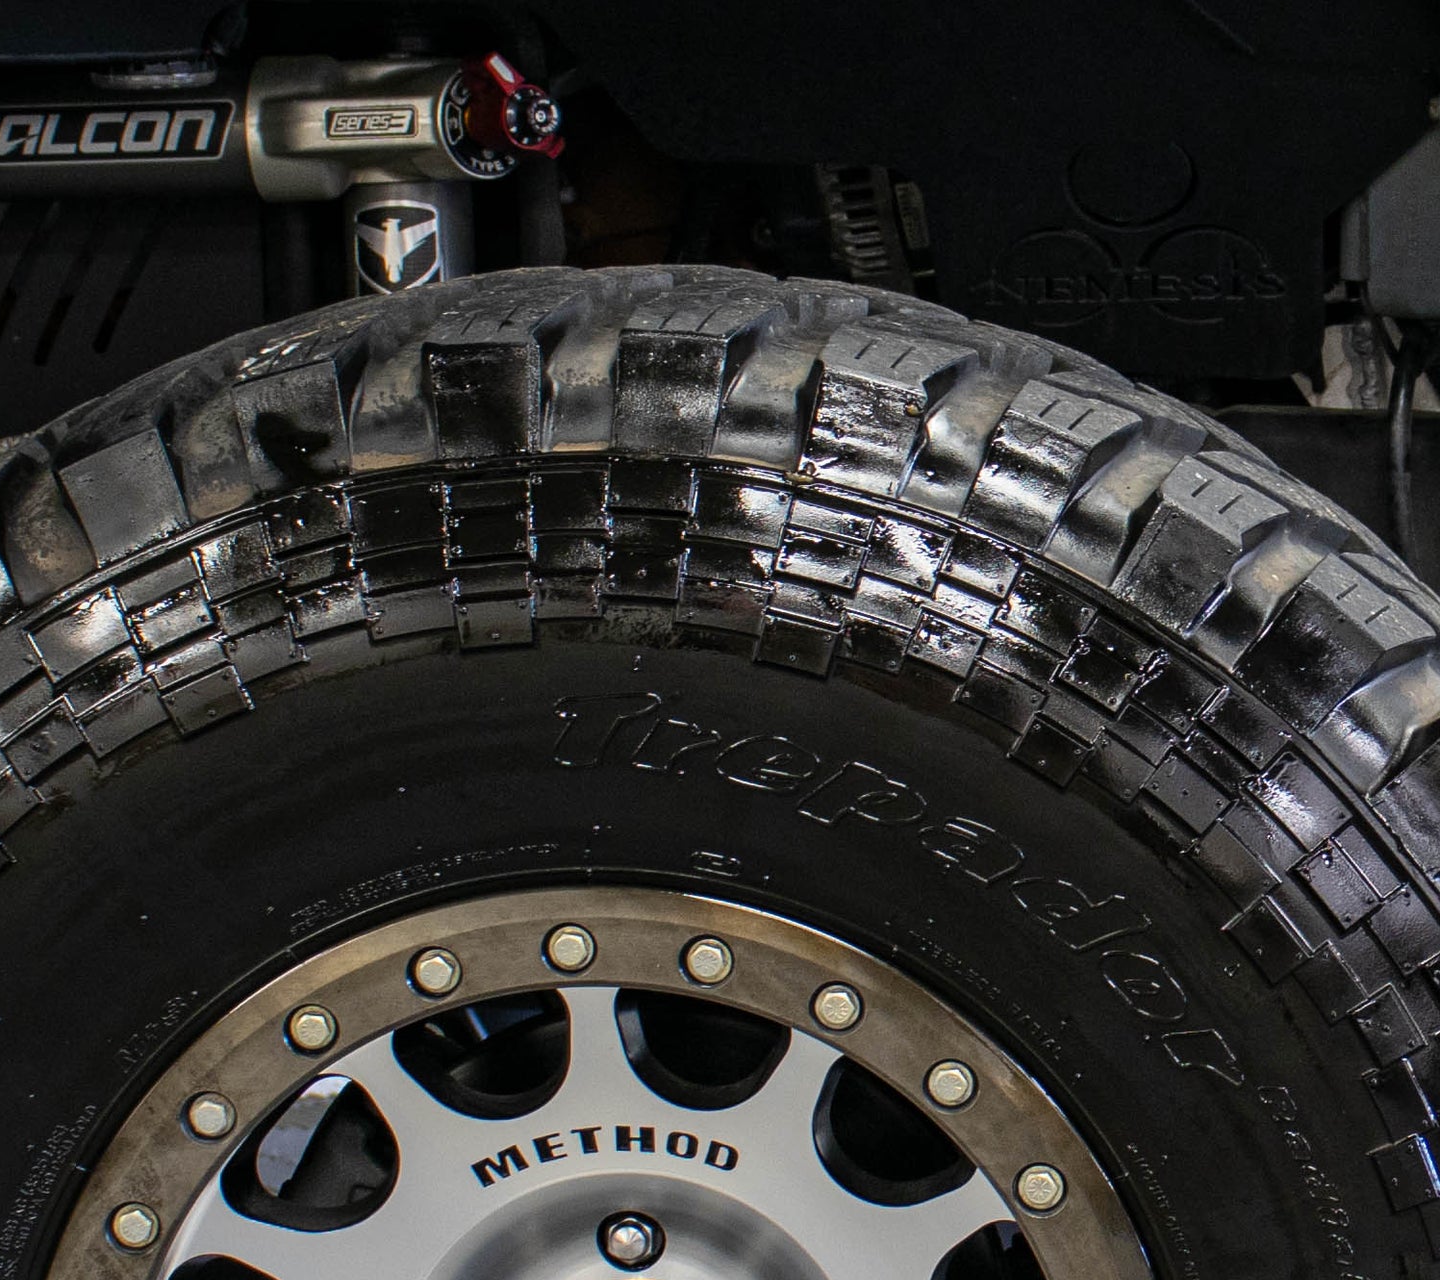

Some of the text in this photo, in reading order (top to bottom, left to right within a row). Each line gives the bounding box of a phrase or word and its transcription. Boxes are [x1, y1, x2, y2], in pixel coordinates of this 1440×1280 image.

[469, 156, 504, 172] TYPE
[554, 691, 1244, 1087] Trepador
[470, 1125, 740, 1188] METHOD
